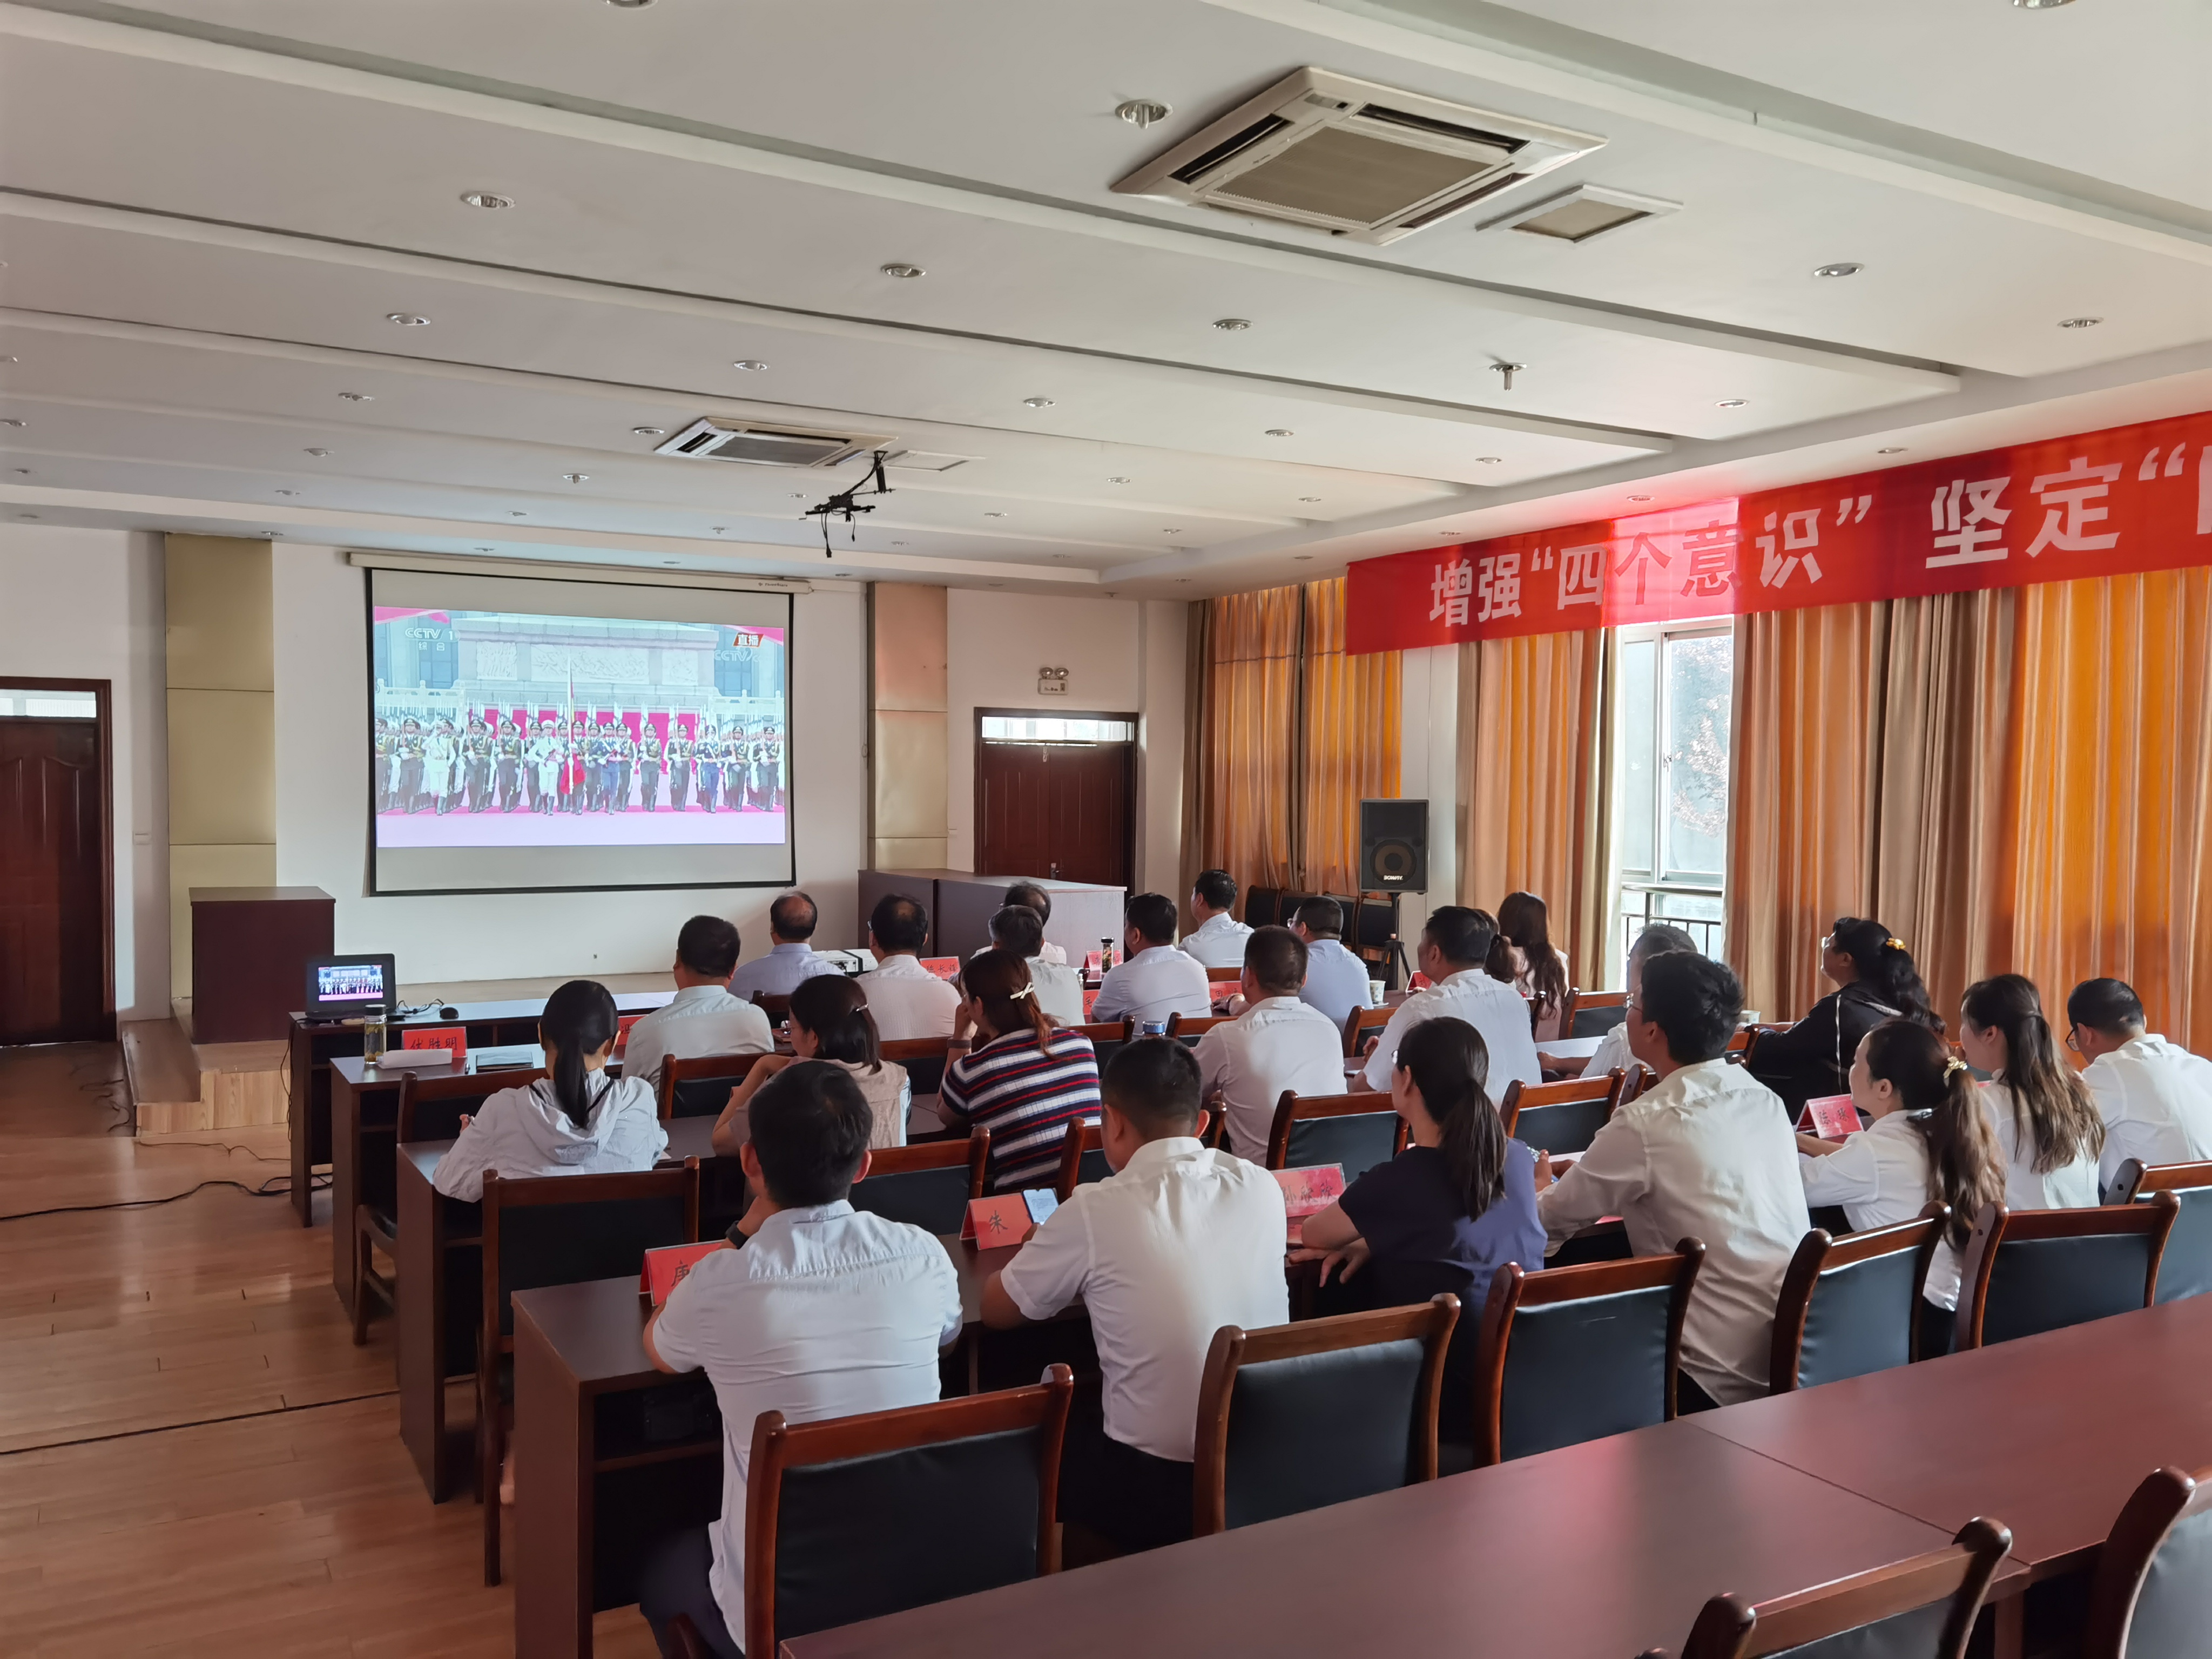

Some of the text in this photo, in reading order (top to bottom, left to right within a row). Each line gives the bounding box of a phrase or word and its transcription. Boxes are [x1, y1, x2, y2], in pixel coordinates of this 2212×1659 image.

[1429, 441, 2212, 628] 增强“四个意识” 坚定“
[404, 627, 441, 639] CCTV
[737, 633, 759, 646] 直播
